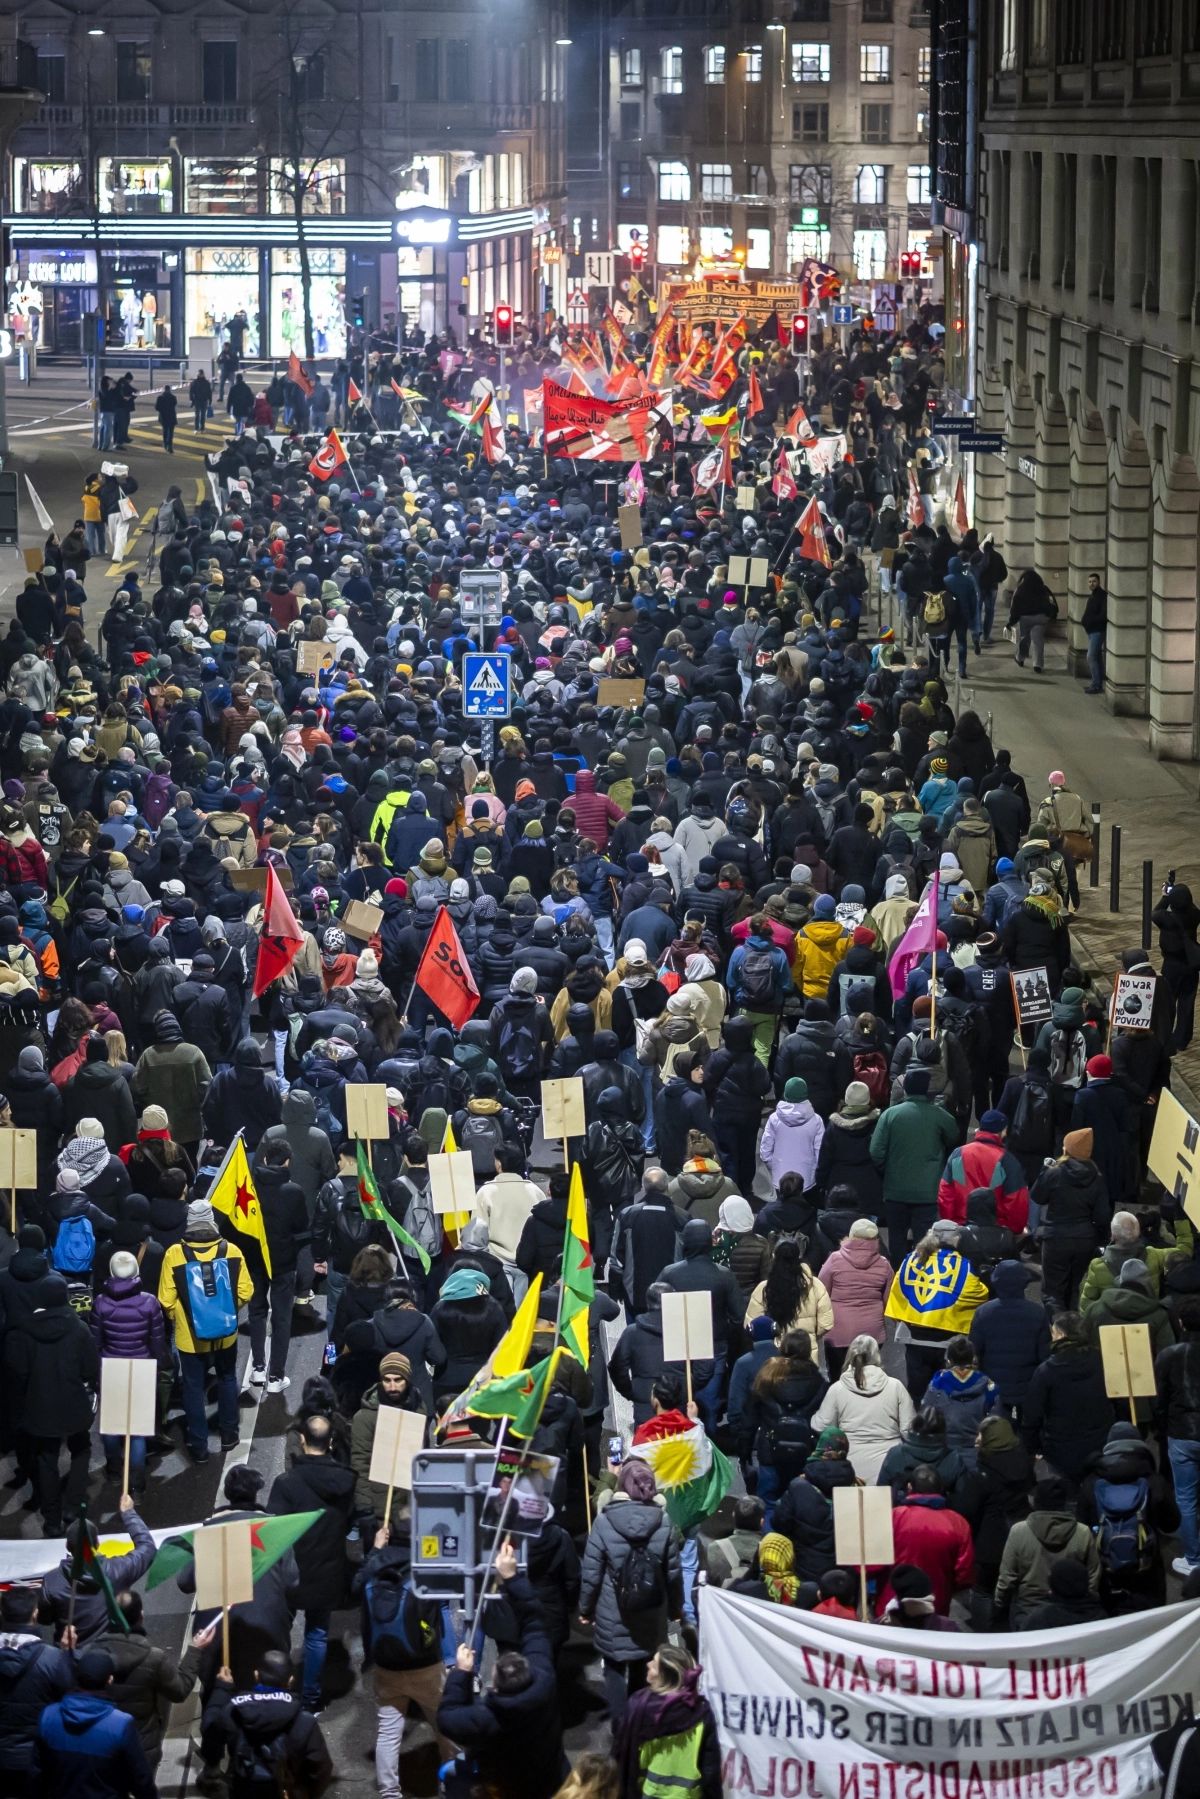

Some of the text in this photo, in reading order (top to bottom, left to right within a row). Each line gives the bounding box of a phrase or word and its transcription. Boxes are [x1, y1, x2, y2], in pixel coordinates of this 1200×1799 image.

[1120, 980, 1131, 988] NO
[1115, 1008, 1125, 1016] NO
[1115, 1016, 1150, 1027] POVERTY
[254, 1692, 293, 1703] SQUAD
